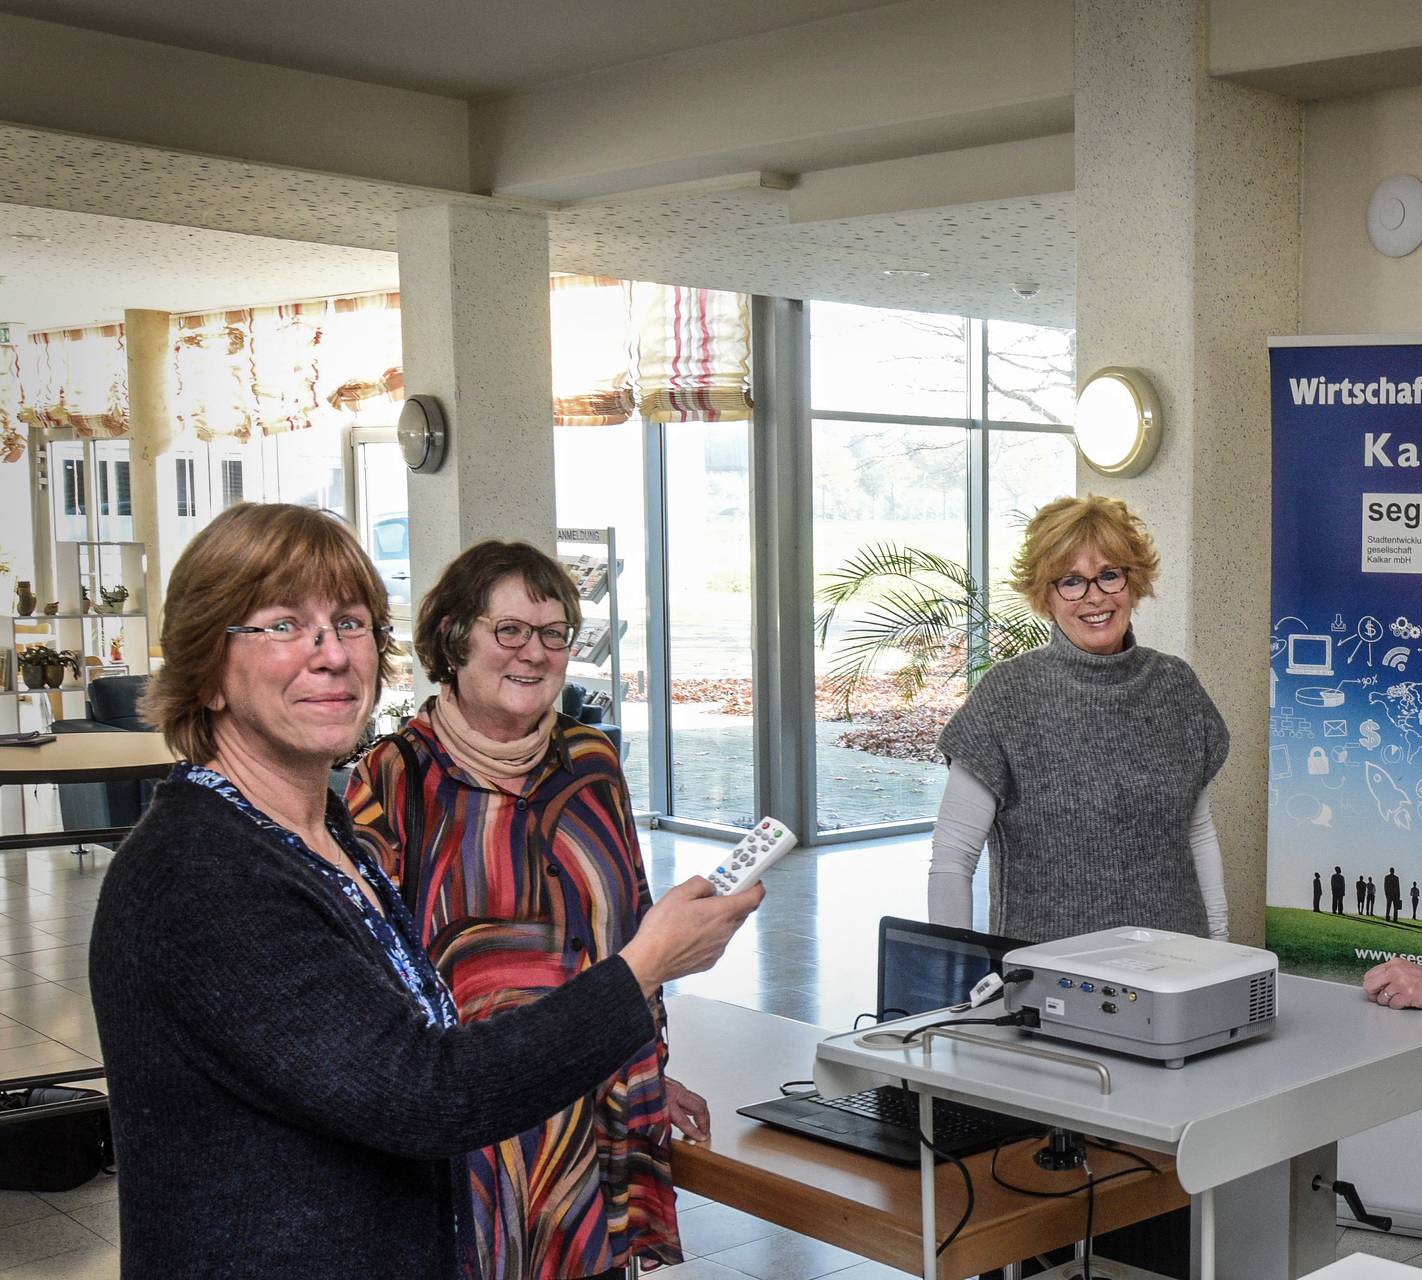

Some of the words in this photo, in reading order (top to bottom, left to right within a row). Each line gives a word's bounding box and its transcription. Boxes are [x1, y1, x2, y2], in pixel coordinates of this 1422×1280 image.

[1368, 502, 1421, 529] seg
[1367, 546, 1412, 555] gesellschaft
[1367, 556, 1392, 564] Kalkar
[1393, 556, 1412, 564] mbH
